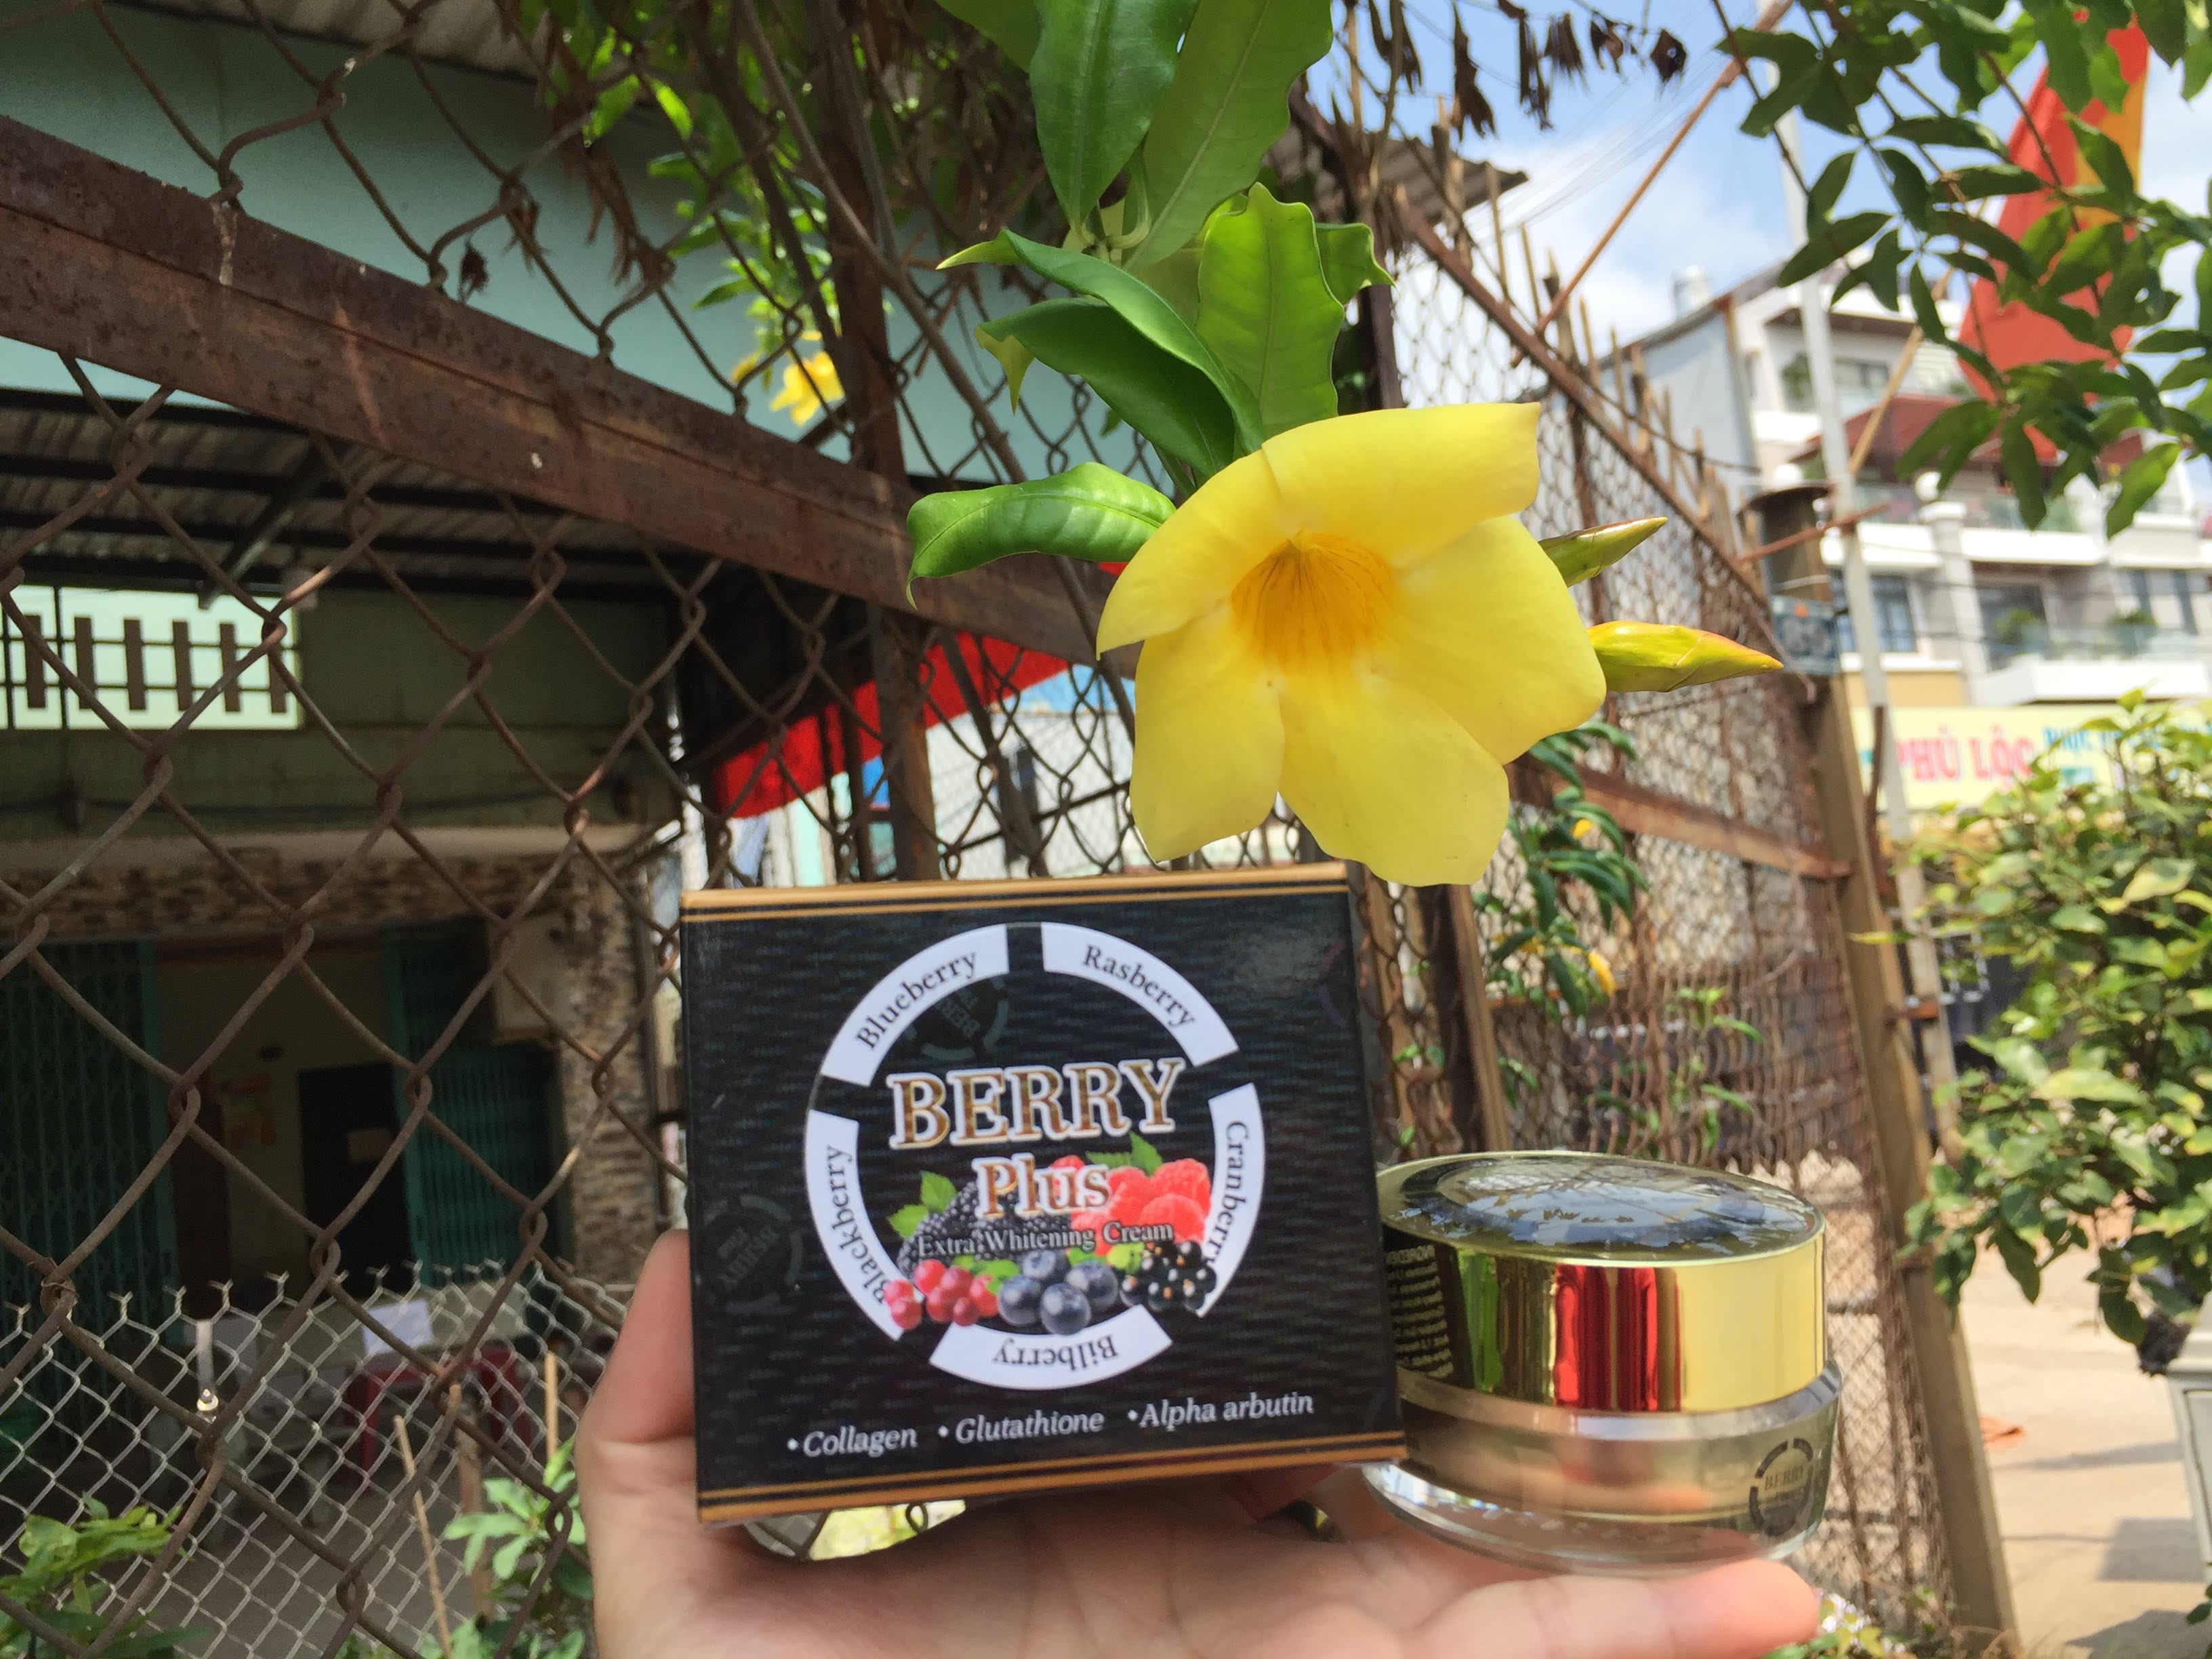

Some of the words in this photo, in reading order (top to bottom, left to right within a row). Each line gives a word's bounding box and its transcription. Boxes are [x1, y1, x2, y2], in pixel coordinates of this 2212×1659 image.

[857, 951, 976, 1049] Blueberry
[1082, 944, 1195, 1027] Rasberry
[886, 1058, 1186, 1149] BERRY
[972, 1153, 1111, 1219] Plus
[918, 1235, 975, 1257] Extra
[983, 1227, 1095, 1252] Whitening
[1102, 1222, 1174, 1244] Cream
[993, 1334, 1120, 1371] Bilberry
[803, 1425, 918, 1457] Collagen
[956, 1409, 1105, 1444] Glutathione
[1139, 1397, 1218, 1431] Alpha
[1223, 1391, 1314, 1422] arbutin
